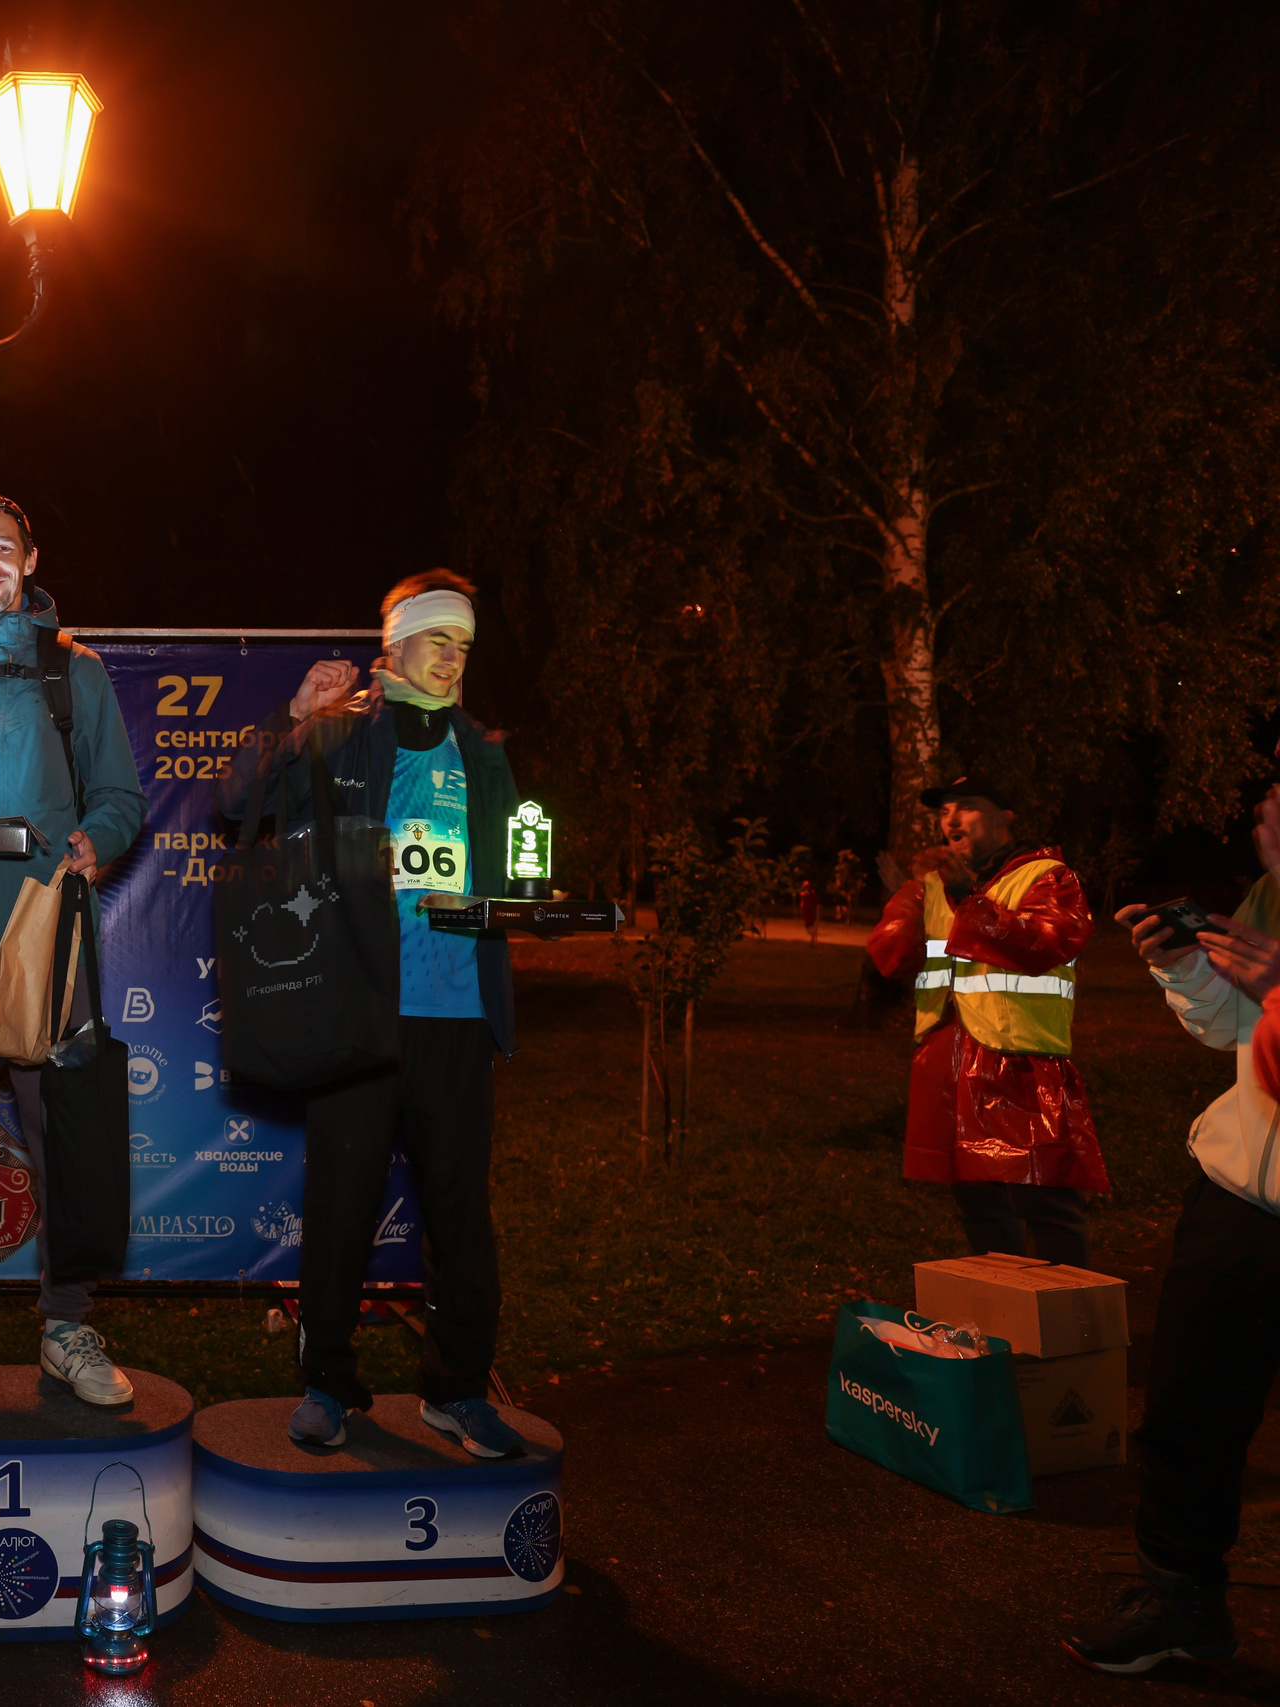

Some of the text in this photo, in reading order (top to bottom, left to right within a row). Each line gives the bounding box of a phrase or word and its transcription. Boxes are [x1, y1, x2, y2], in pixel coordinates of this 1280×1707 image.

[156, 675, 224, 717] 27
[155, 756, 233, 780] 2025
[154, 832, 227, 856] парк
[522, 830, 536, 851] 3
[143, 1153, 177, 1164] ЕСТЬ
[15, 1201, 30, 1234] ЗАБЕГ
[838, 1370, 940, 1447] kaspersky
[404, 1496, 439, 1552] 3
